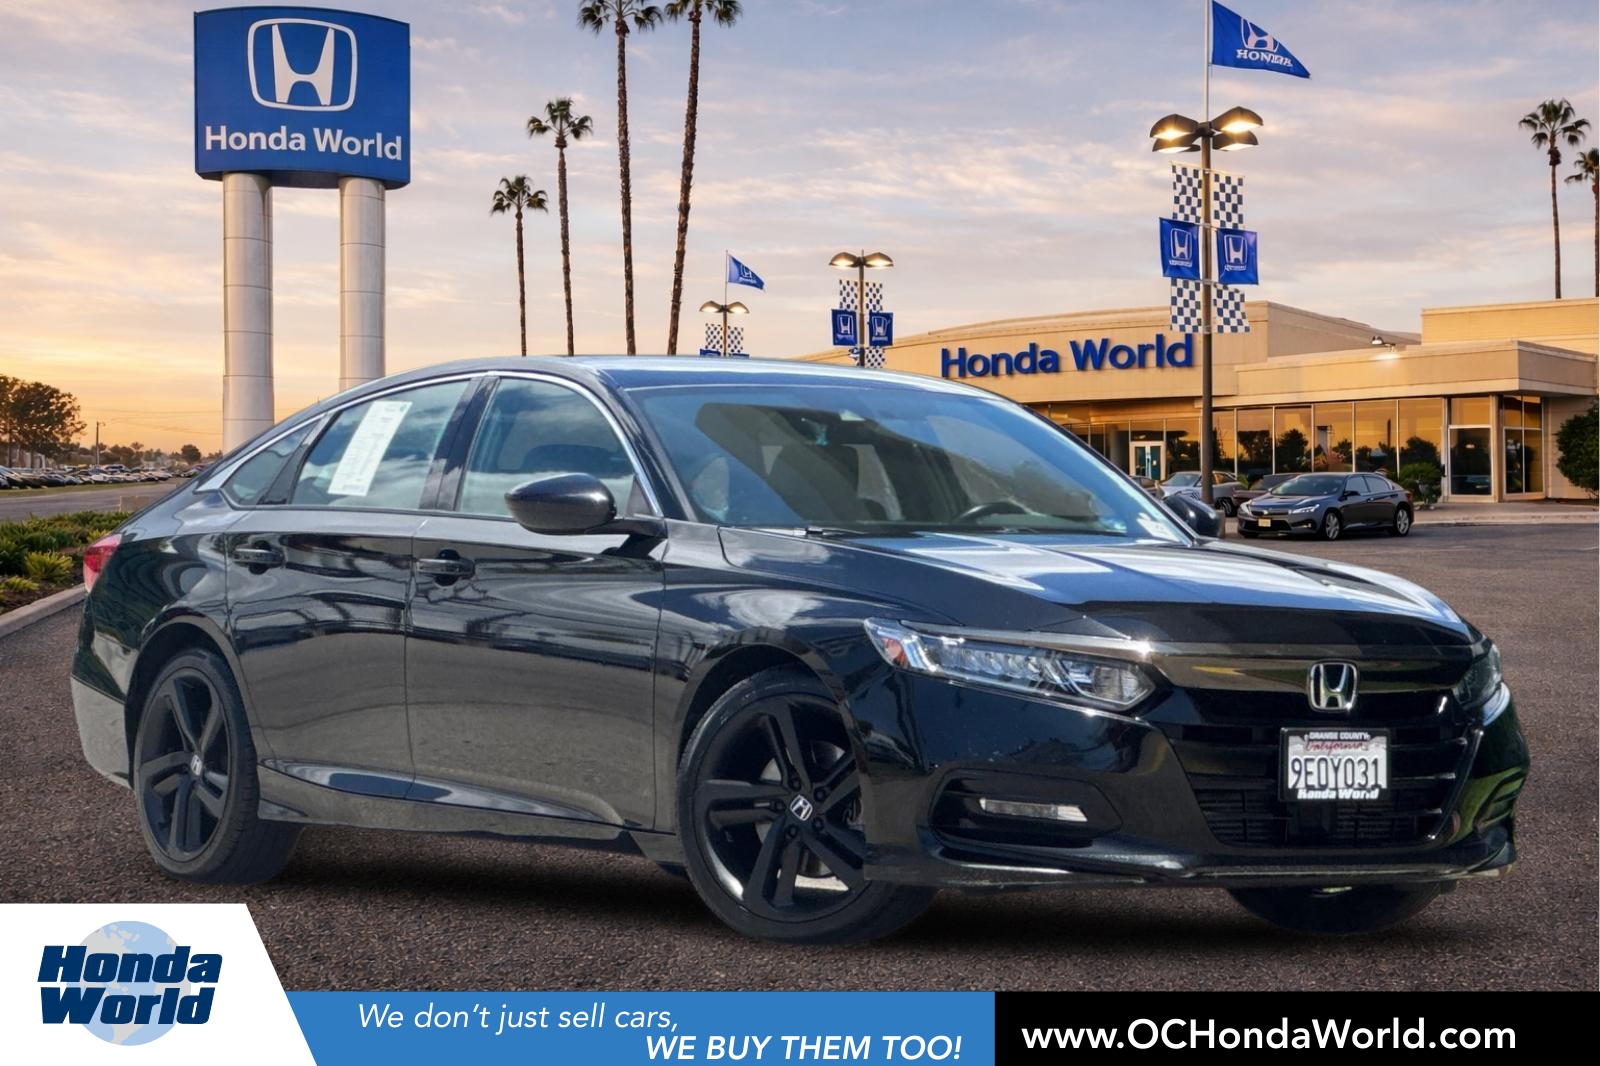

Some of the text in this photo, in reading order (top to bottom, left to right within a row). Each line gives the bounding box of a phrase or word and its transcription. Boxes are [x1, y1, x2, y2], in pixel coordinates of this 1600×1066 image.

[205, 125, 403, 161] Honda World
[941, 333, 1195, 378] Honda World
